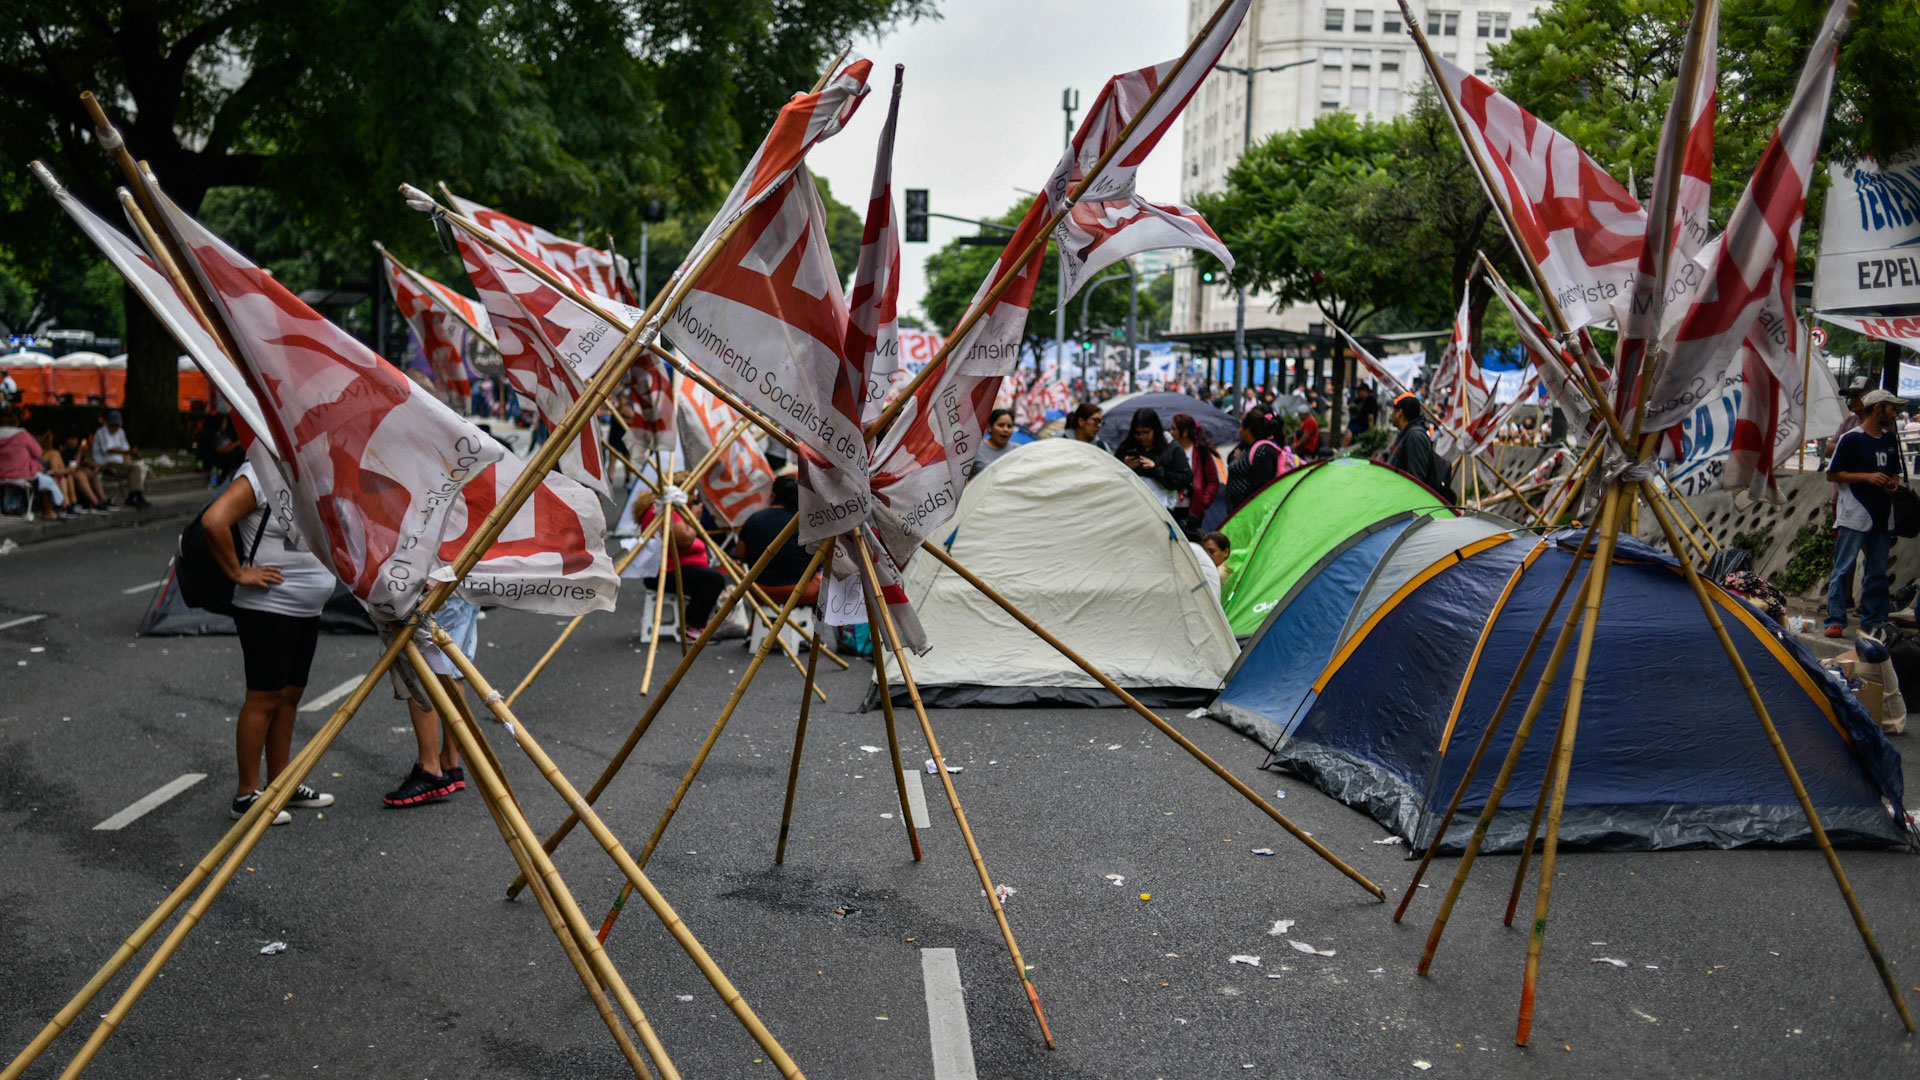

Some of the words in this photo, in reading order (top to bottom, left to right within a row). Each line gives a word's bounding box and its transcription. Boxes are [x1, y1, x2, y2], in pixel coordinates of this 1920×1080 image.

[671, 304, 758, 383] Movimiento
[759, 371, 835, 444] Socialista
[836, 433, 856, 459] de
[953, 430, 970, 455] de
[1875, 452, 1888, 467] 10
[461, 575, 597, 601] Trabajadores
